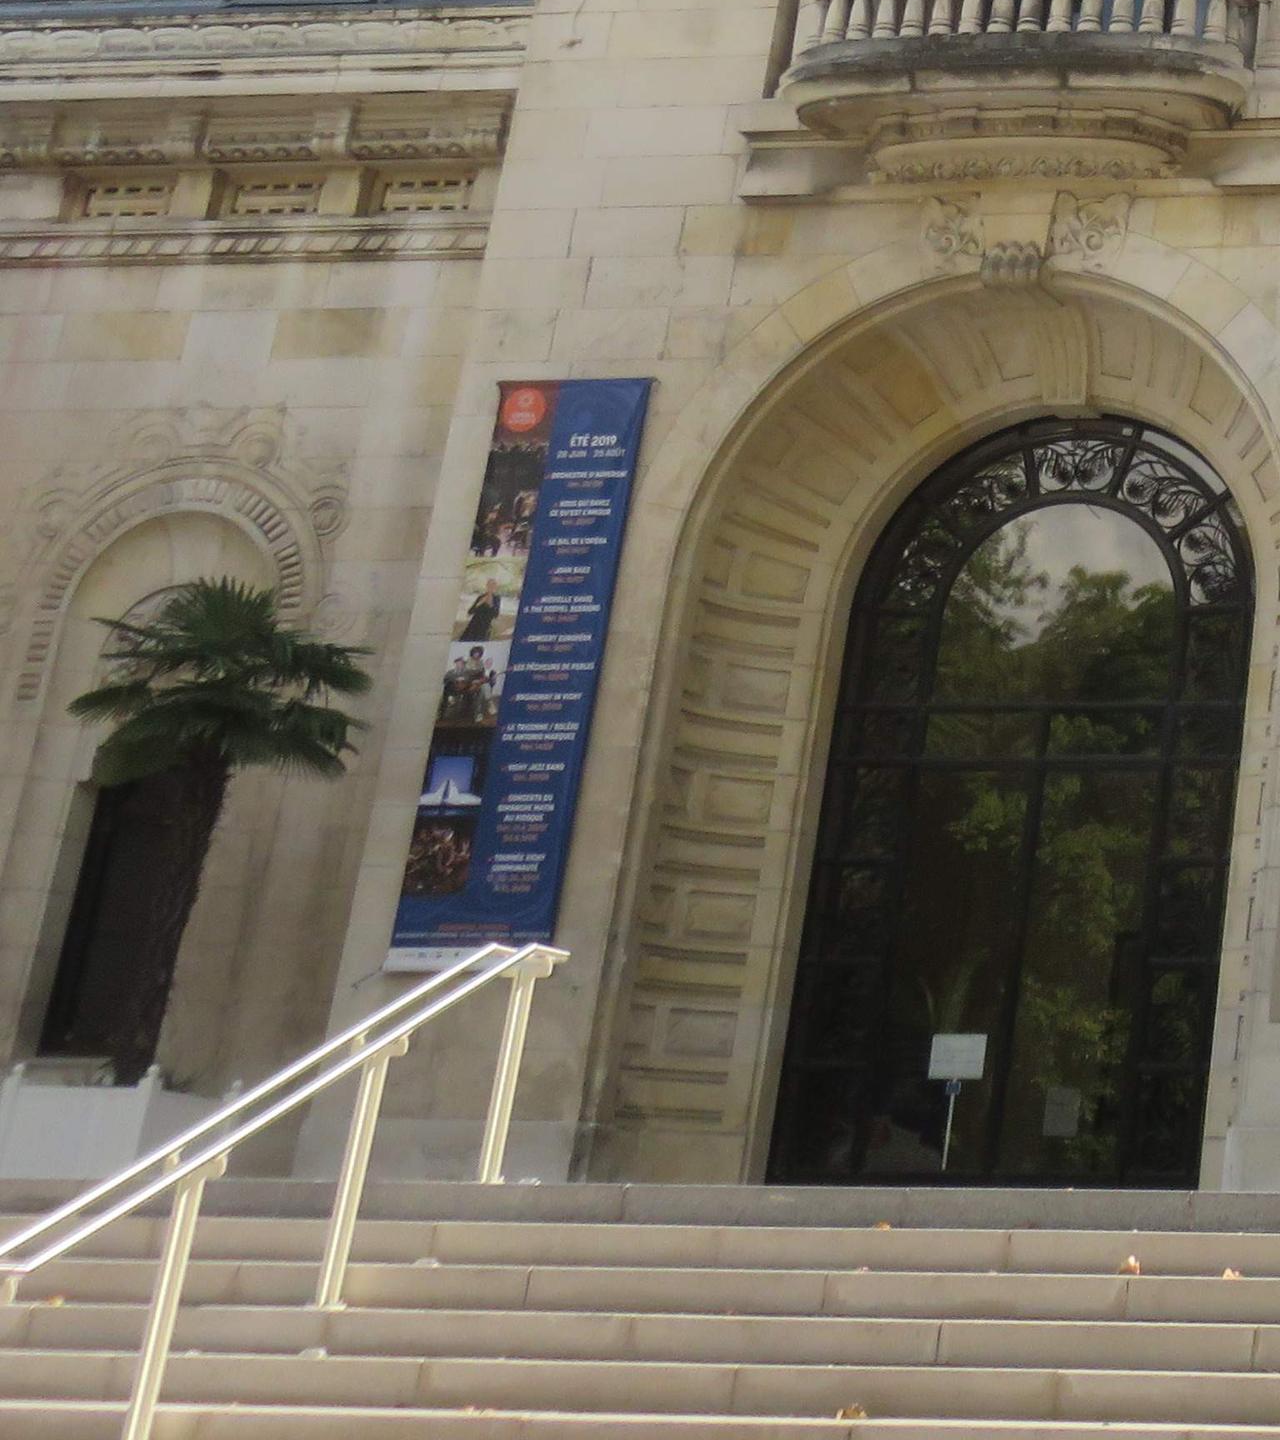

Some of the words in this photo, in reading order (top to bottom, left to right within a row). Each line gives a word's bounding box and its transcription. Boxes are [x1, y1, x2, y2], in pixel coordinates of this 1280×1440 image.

[570, 433, 590, 447] ÉTÉ
[591, 435, 617, 447] 2019
[569, 450, 587, 458] JUIN
[605, 448, 626, 457] AOÛT
